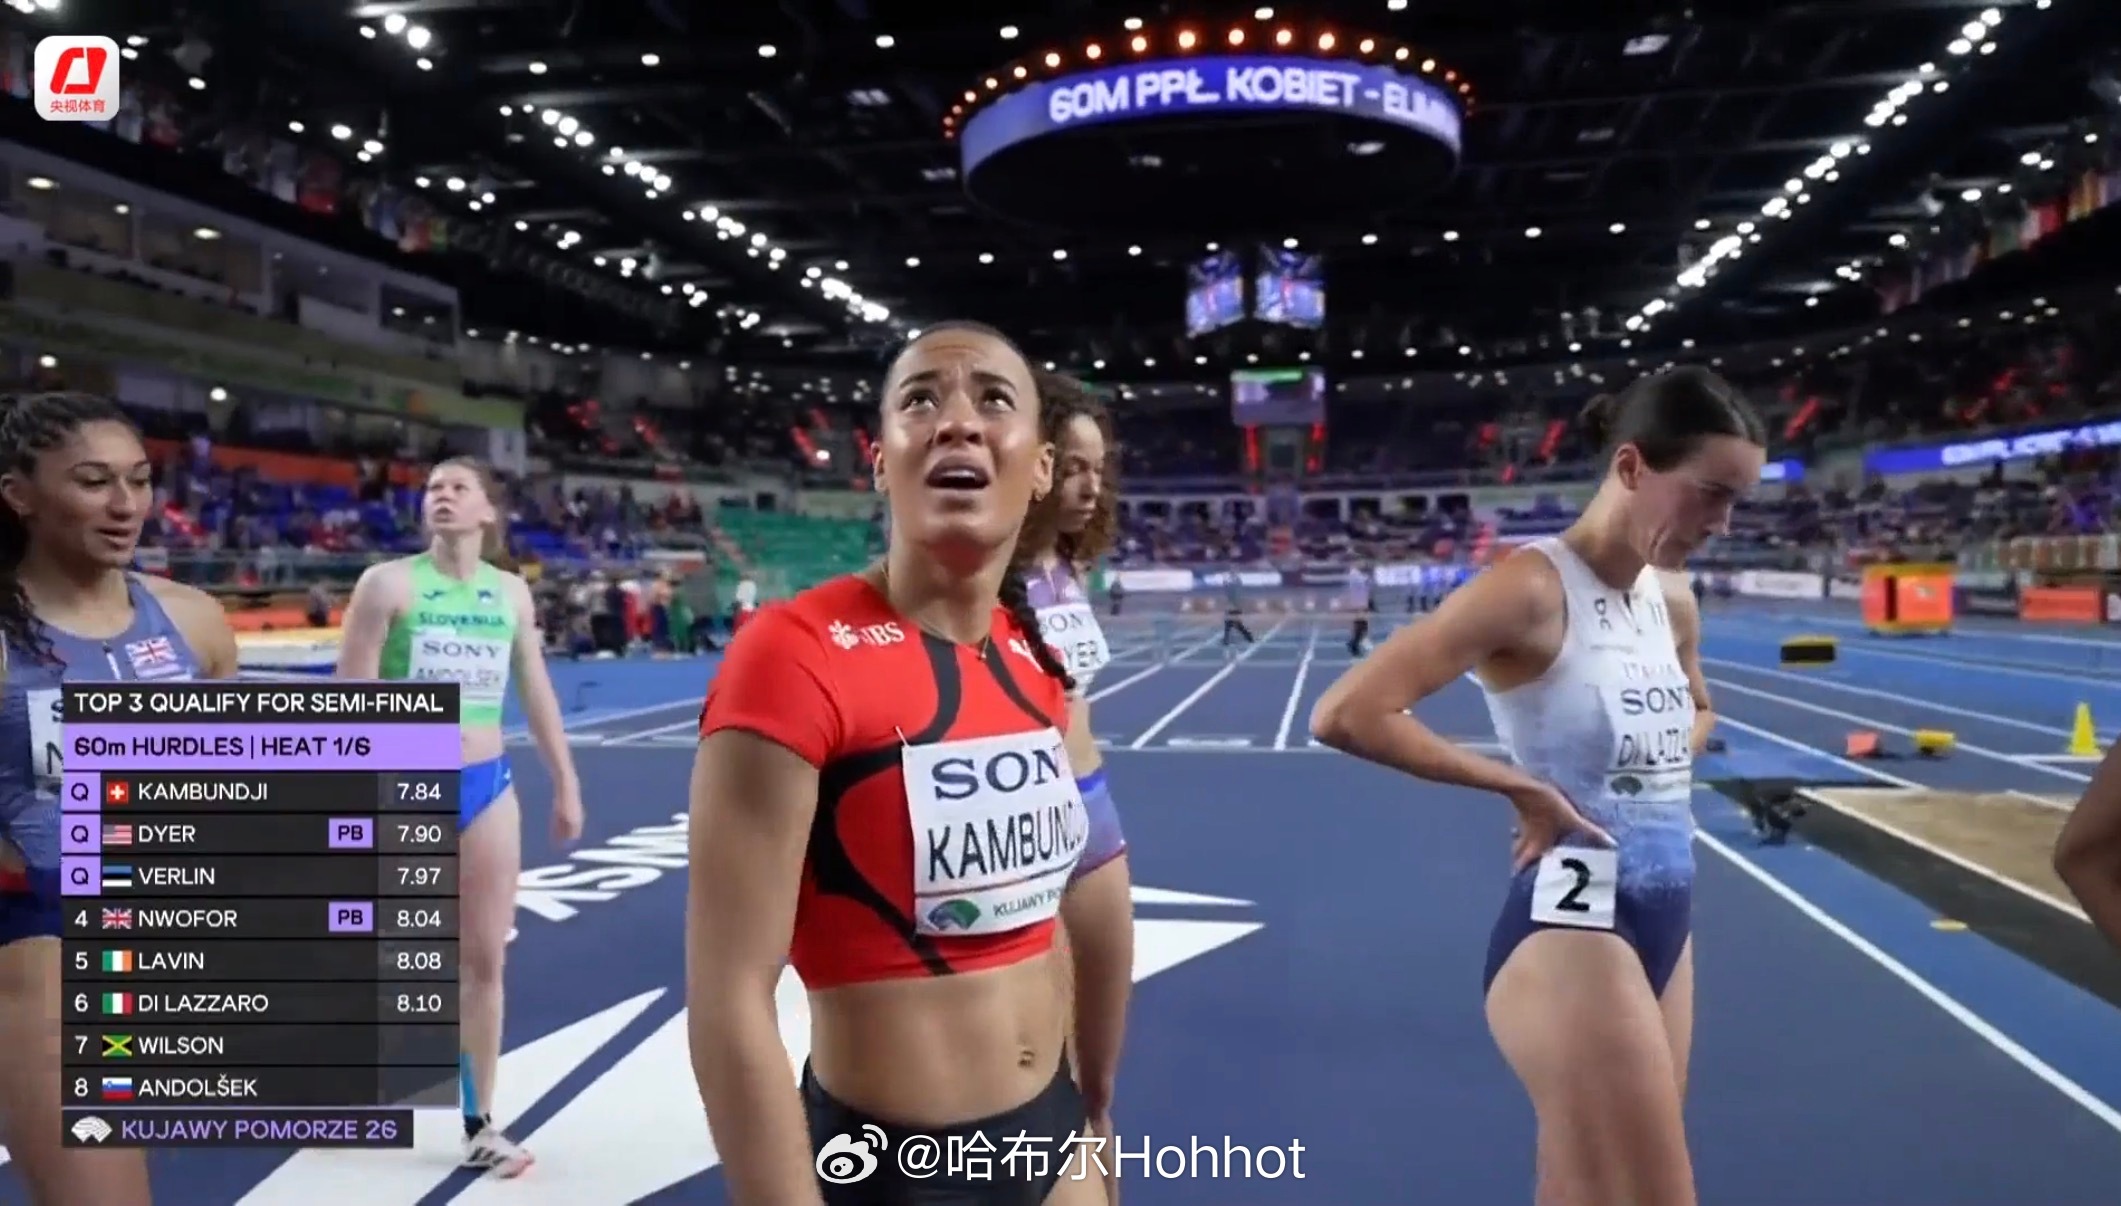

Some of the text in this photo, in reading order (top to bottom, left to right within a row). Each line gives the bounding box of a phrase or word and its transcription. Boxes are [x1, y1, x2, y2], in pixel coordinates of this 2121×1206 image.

[1049, 75, 1129, 123] 60M
[1227, 66, 1361, 107] KOBIET
[422, 640, 500, 659] SONY
[1556, 858, 1590, 912] 2
